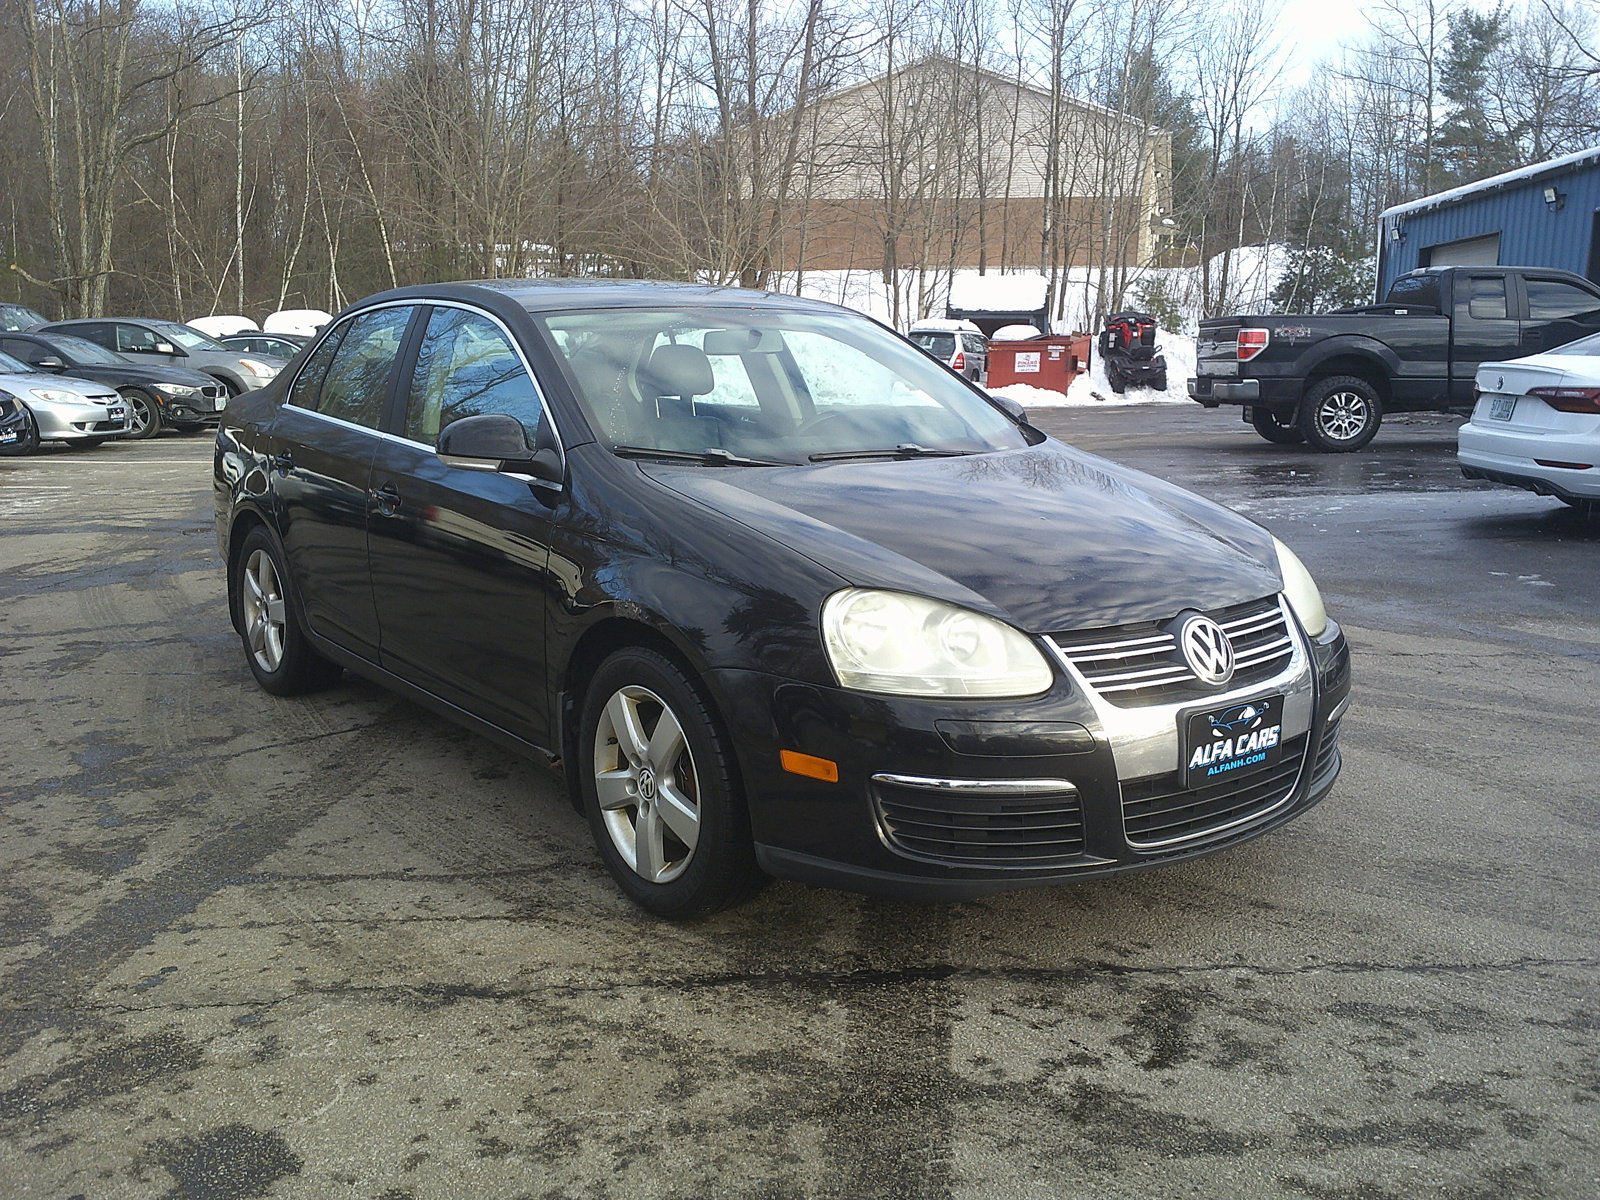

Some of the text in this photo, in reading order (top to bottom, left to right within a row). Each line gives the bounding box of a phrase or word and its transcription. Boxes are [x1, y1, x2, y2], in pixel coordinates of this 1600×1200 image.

[1189, 724, 1281, 769] ALFA CARS
[1207, 752, 1266, 776] ALFANH.COM
